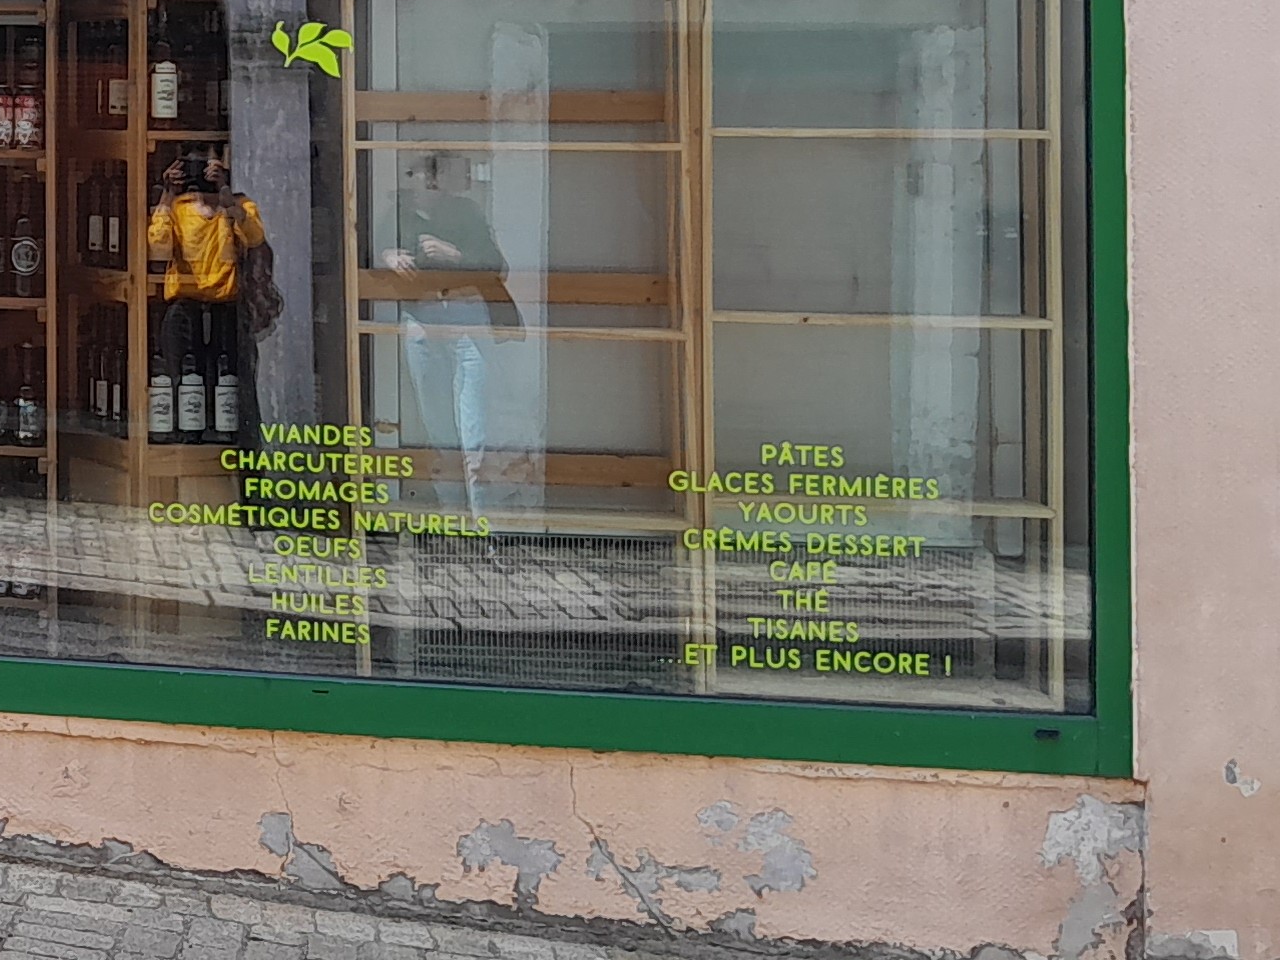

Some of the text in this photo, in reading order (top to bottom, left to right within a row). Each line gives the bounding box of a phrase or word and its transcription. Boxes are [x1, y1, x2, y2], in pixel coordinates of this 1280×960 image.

[259, 423, 372, 446] VIANDES
[220, 450, 414, 477] CHARCUTERIES
[761, 441, 845, 468] PÂTES
[245, 478, 389, 504] FROMAGES
[668, 471, 940, 500] GLACES FERMIÈRES
[148, 503, 490, 537] COSMÉTIQUES NATURELS
[739, 501, 868, 526] YAOURTS
[273, 536, 361, 559] OEUFS
[807, 533, 926, 557] DESSERT
[248, 563, 388, 589] LENTILLES
[769, 559, 837, 583] CAFÉ
[271, 591, 365, 615] HUILES
[775, 589, 830, 613] THÉ
[266, 619, 370, 644] FARINES
[747, 617, 860, 643] TISANES
[731, 646, 801, 669] PLUS
[816, 650, 930, 676] ENCORE
[944, 656, 952, 677] !
